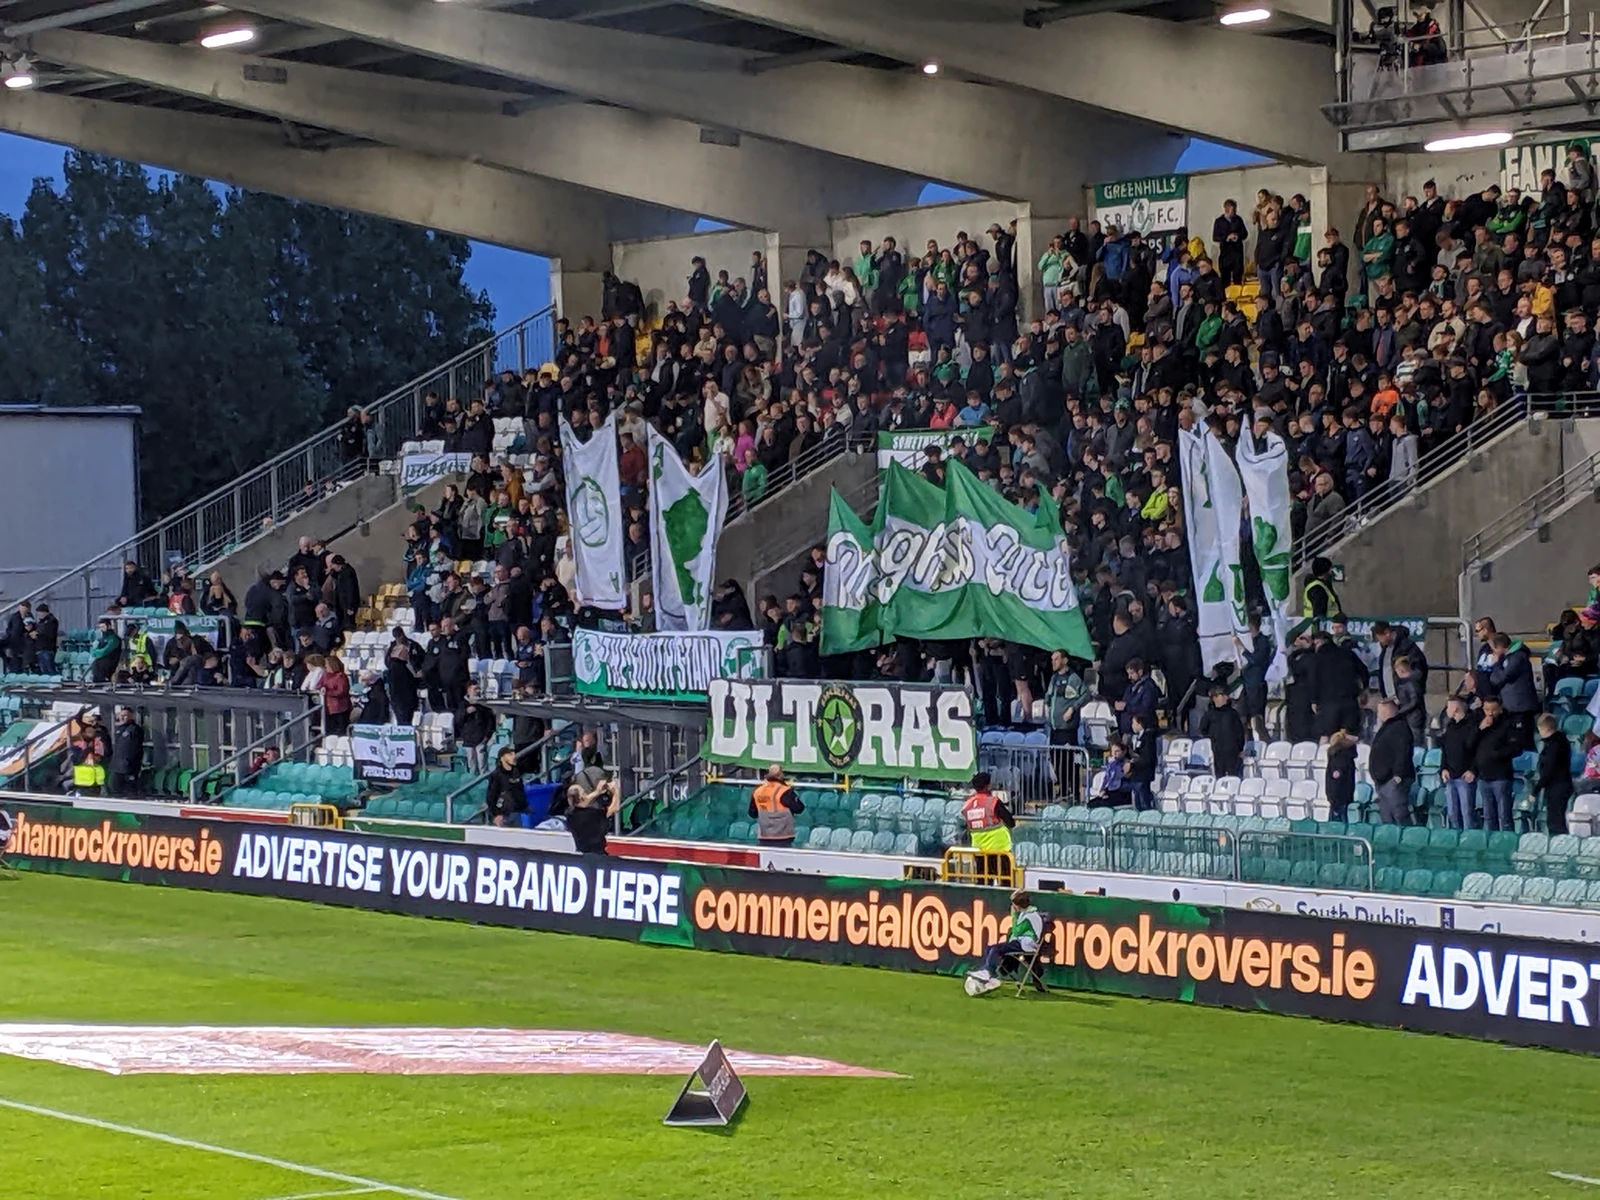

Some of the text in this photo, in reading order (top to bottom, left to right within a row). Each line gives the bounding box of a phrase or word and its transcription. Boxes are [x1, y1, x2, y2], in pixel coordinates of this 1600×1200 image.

[1103, 178, 1177, 200] GREENHILLS
[233, 833, 384, 893] ADVERTISE
[389, 848, 470, 903] YOUR
[474, 857, 588, 914] BRAND
[593, 868, 680, 926] HERE
